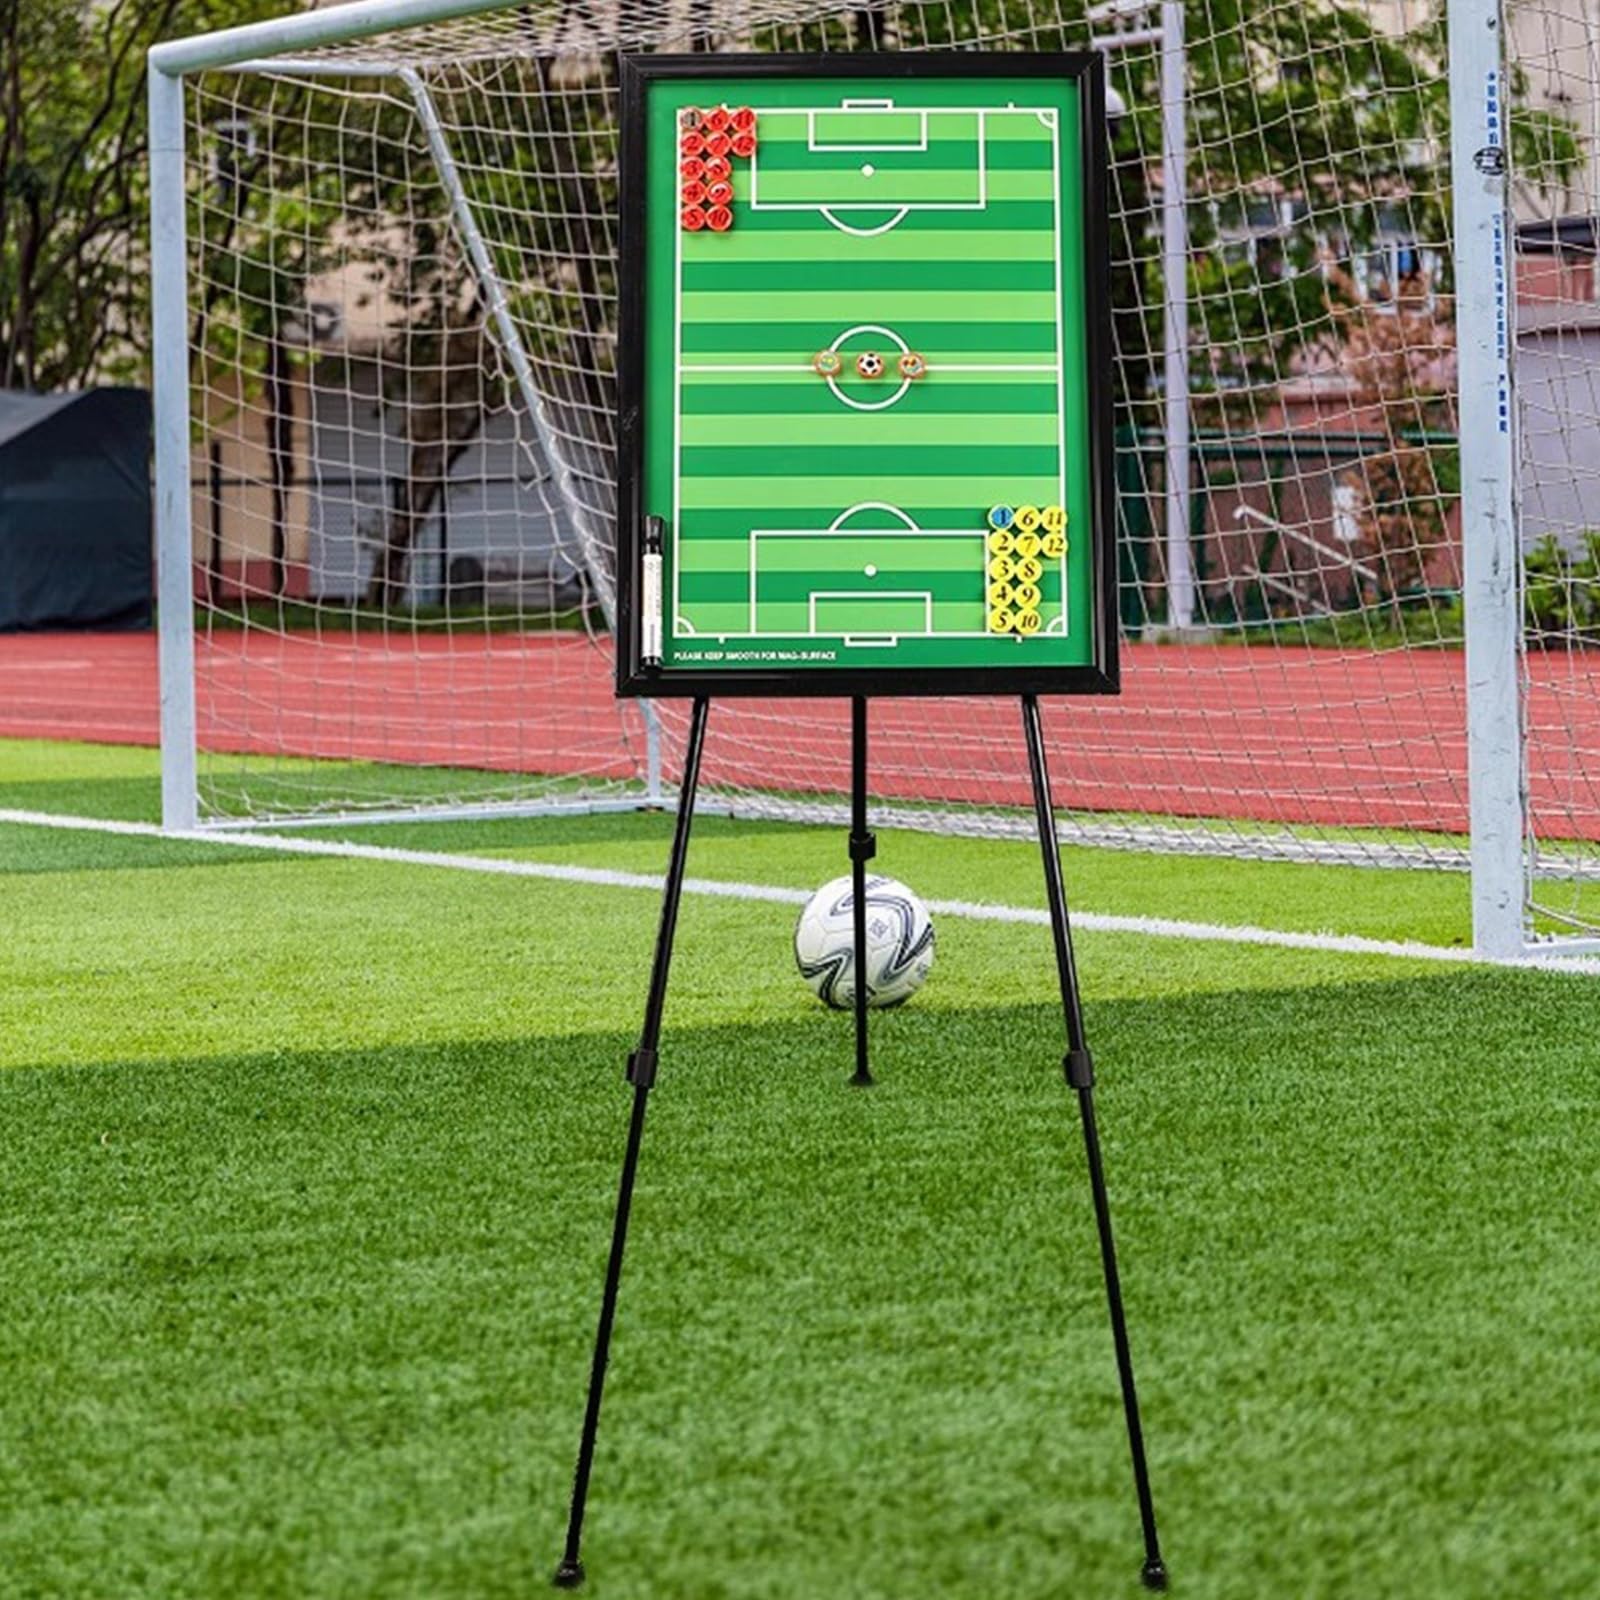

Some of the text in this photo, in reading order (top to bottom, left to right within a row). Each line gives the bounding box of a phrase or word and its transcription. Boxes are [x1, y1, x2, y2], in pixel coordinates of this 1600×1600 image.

[1022, 509, 1034, 527] 6
[1047, 511, 1062, 526] 11
[998, 534, 1009, 551] 2
[1023, 535, 1034, 552] 7
[1047, 537, 1064, 553] 12
[1024, 561, 1035, 579] 8
[1022, 587, 1034, 604] 9
[995, 611, 1008, 629] 5
[1021, 614, 1039, 629] 10
[673, 651, 702, 661] PLEASE
[704, 651, 724, 661] KEEP
[725, 651, 760, 661] SMOOTH
[761, 651, 776, 661] FOR
